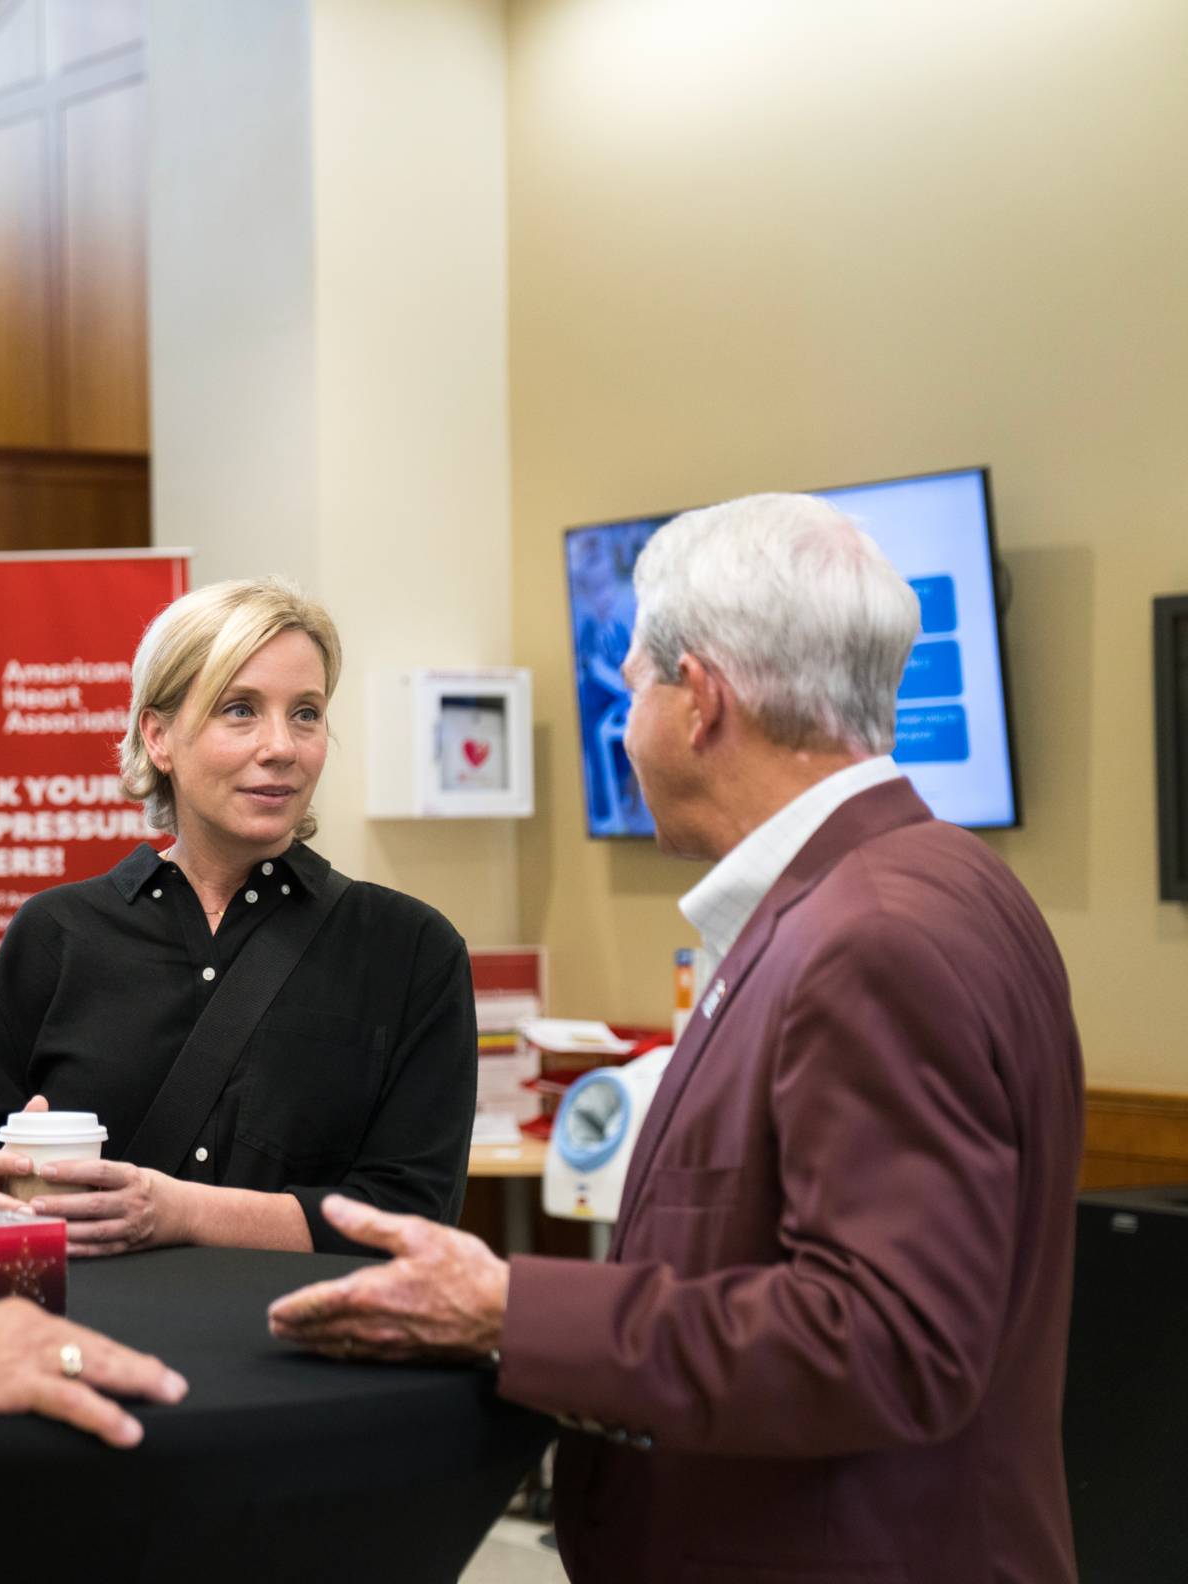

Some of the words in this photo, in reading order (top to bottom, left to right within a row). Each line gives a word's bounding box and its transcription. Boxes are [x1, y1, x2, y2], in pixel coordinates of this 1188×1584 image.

[2, 658, 131, 684] American
[2, 685, 81, 710] Heart
[3, 708, 131, 735] Associati
